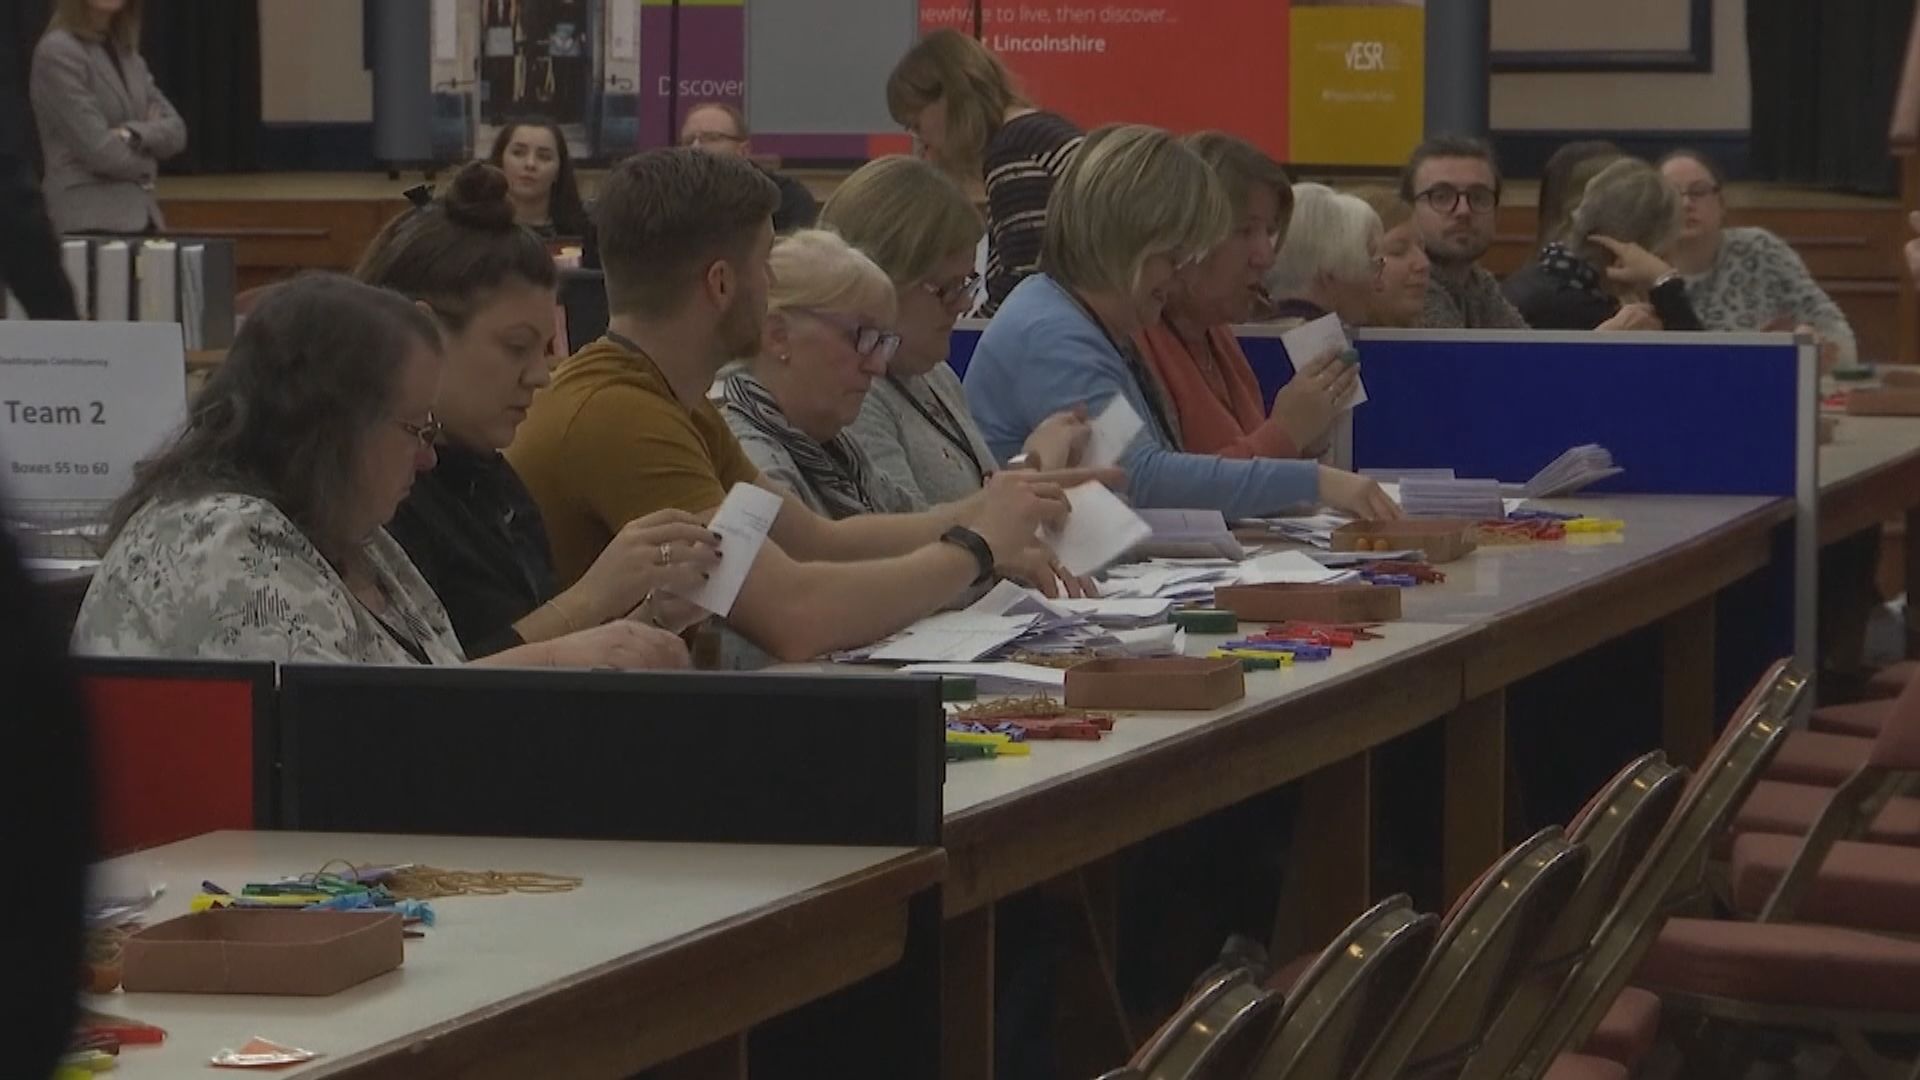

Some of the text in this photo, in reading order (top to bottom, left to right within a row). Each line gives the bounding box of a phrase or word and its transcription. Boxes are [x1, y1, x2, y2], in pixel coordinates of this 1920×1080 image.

[996, 7, 1016, 23] to
[1018, 5, 1050, 24] live,
[1056, 5, 1096, 23] then
[993, 33, 1106, 52] Lincolnshire
[658, 75, 743, 97] Dscover
[4, 400, 106, 425] Team 2
[11, 461, 109, 475] Boxes 55 to 60
